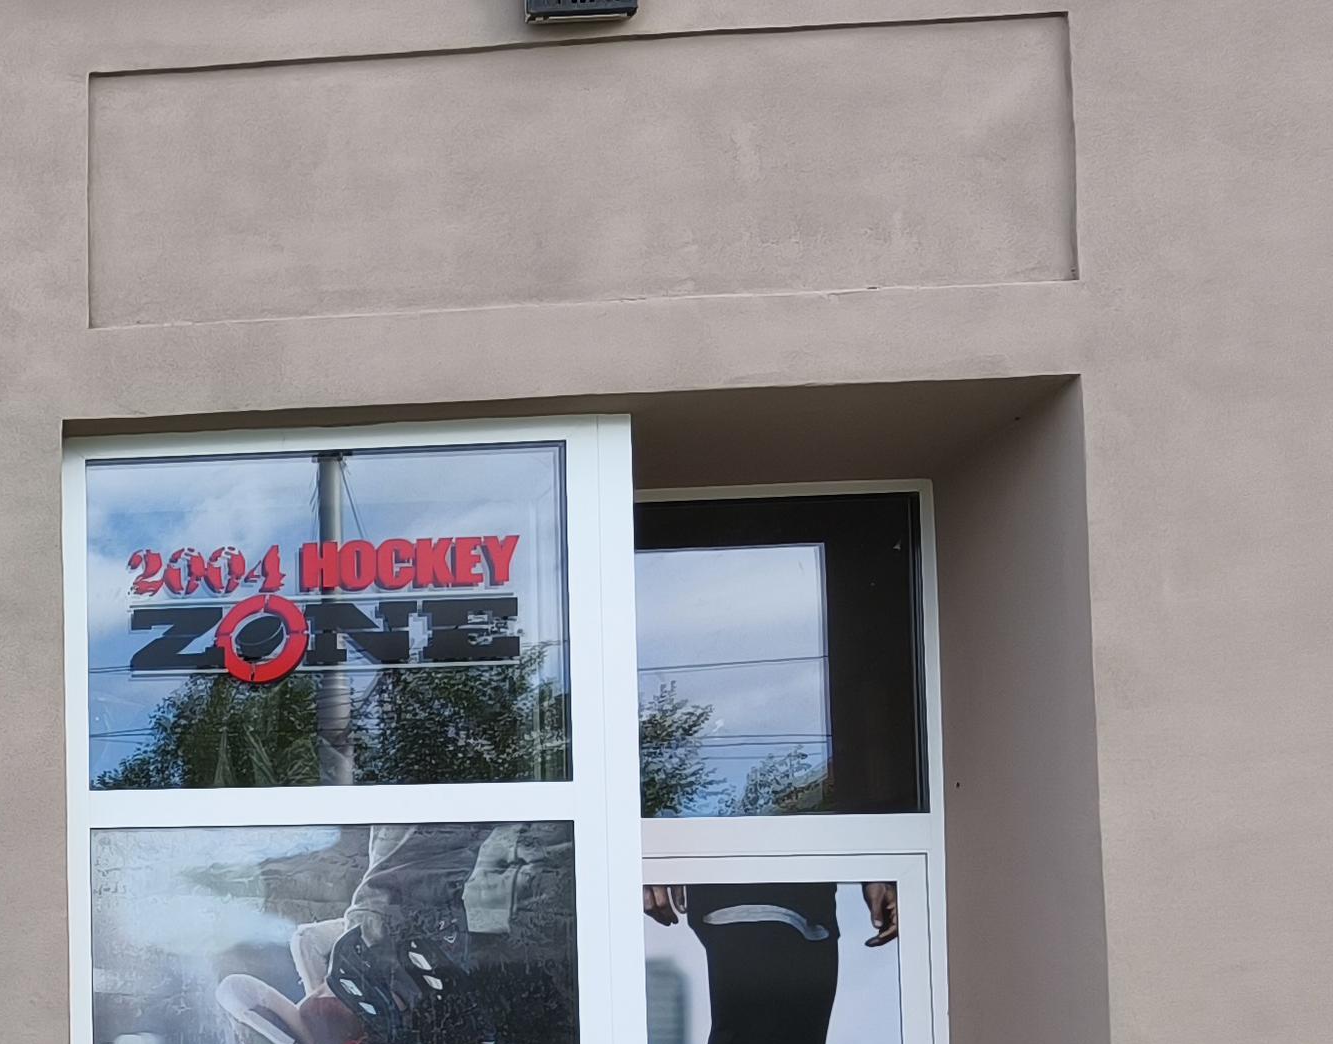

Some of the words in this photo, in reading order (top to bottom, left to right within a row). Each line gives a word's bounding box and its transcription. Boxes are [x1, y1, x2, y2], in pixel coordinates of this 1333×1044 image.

[127, 541, 288, 597] 2004
[298, 534, 520, 594] HOCKEY
[129, 594, 521, 683] ZONE
